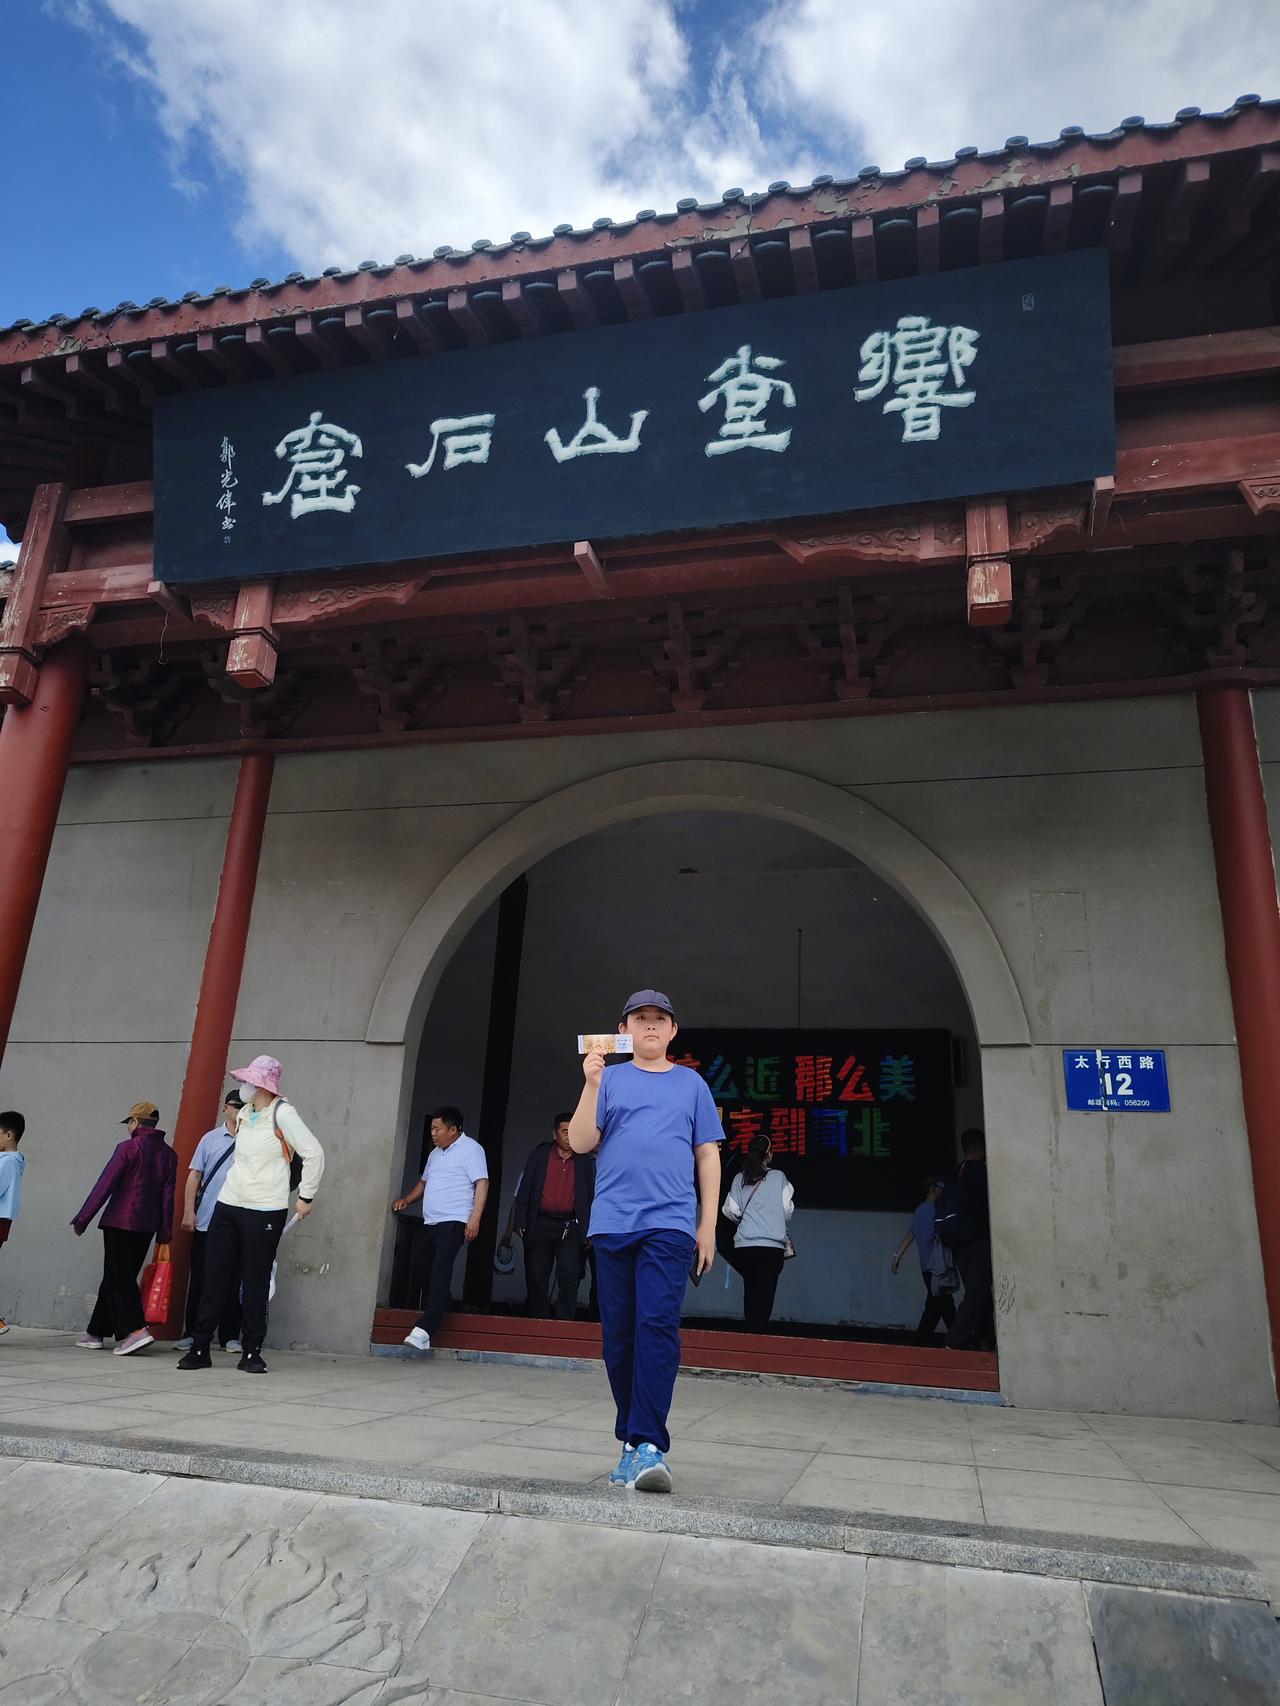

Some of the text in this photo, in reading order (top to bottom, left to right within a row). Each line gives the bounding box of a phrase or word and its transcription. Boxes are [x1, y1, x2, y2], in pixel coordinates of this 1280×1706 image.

[1074, 1055, 1154, 1070] 太行西路
[1104, 1072, 1134, 1096] 12
[1124, 1099, 1150, 1107] 056200
